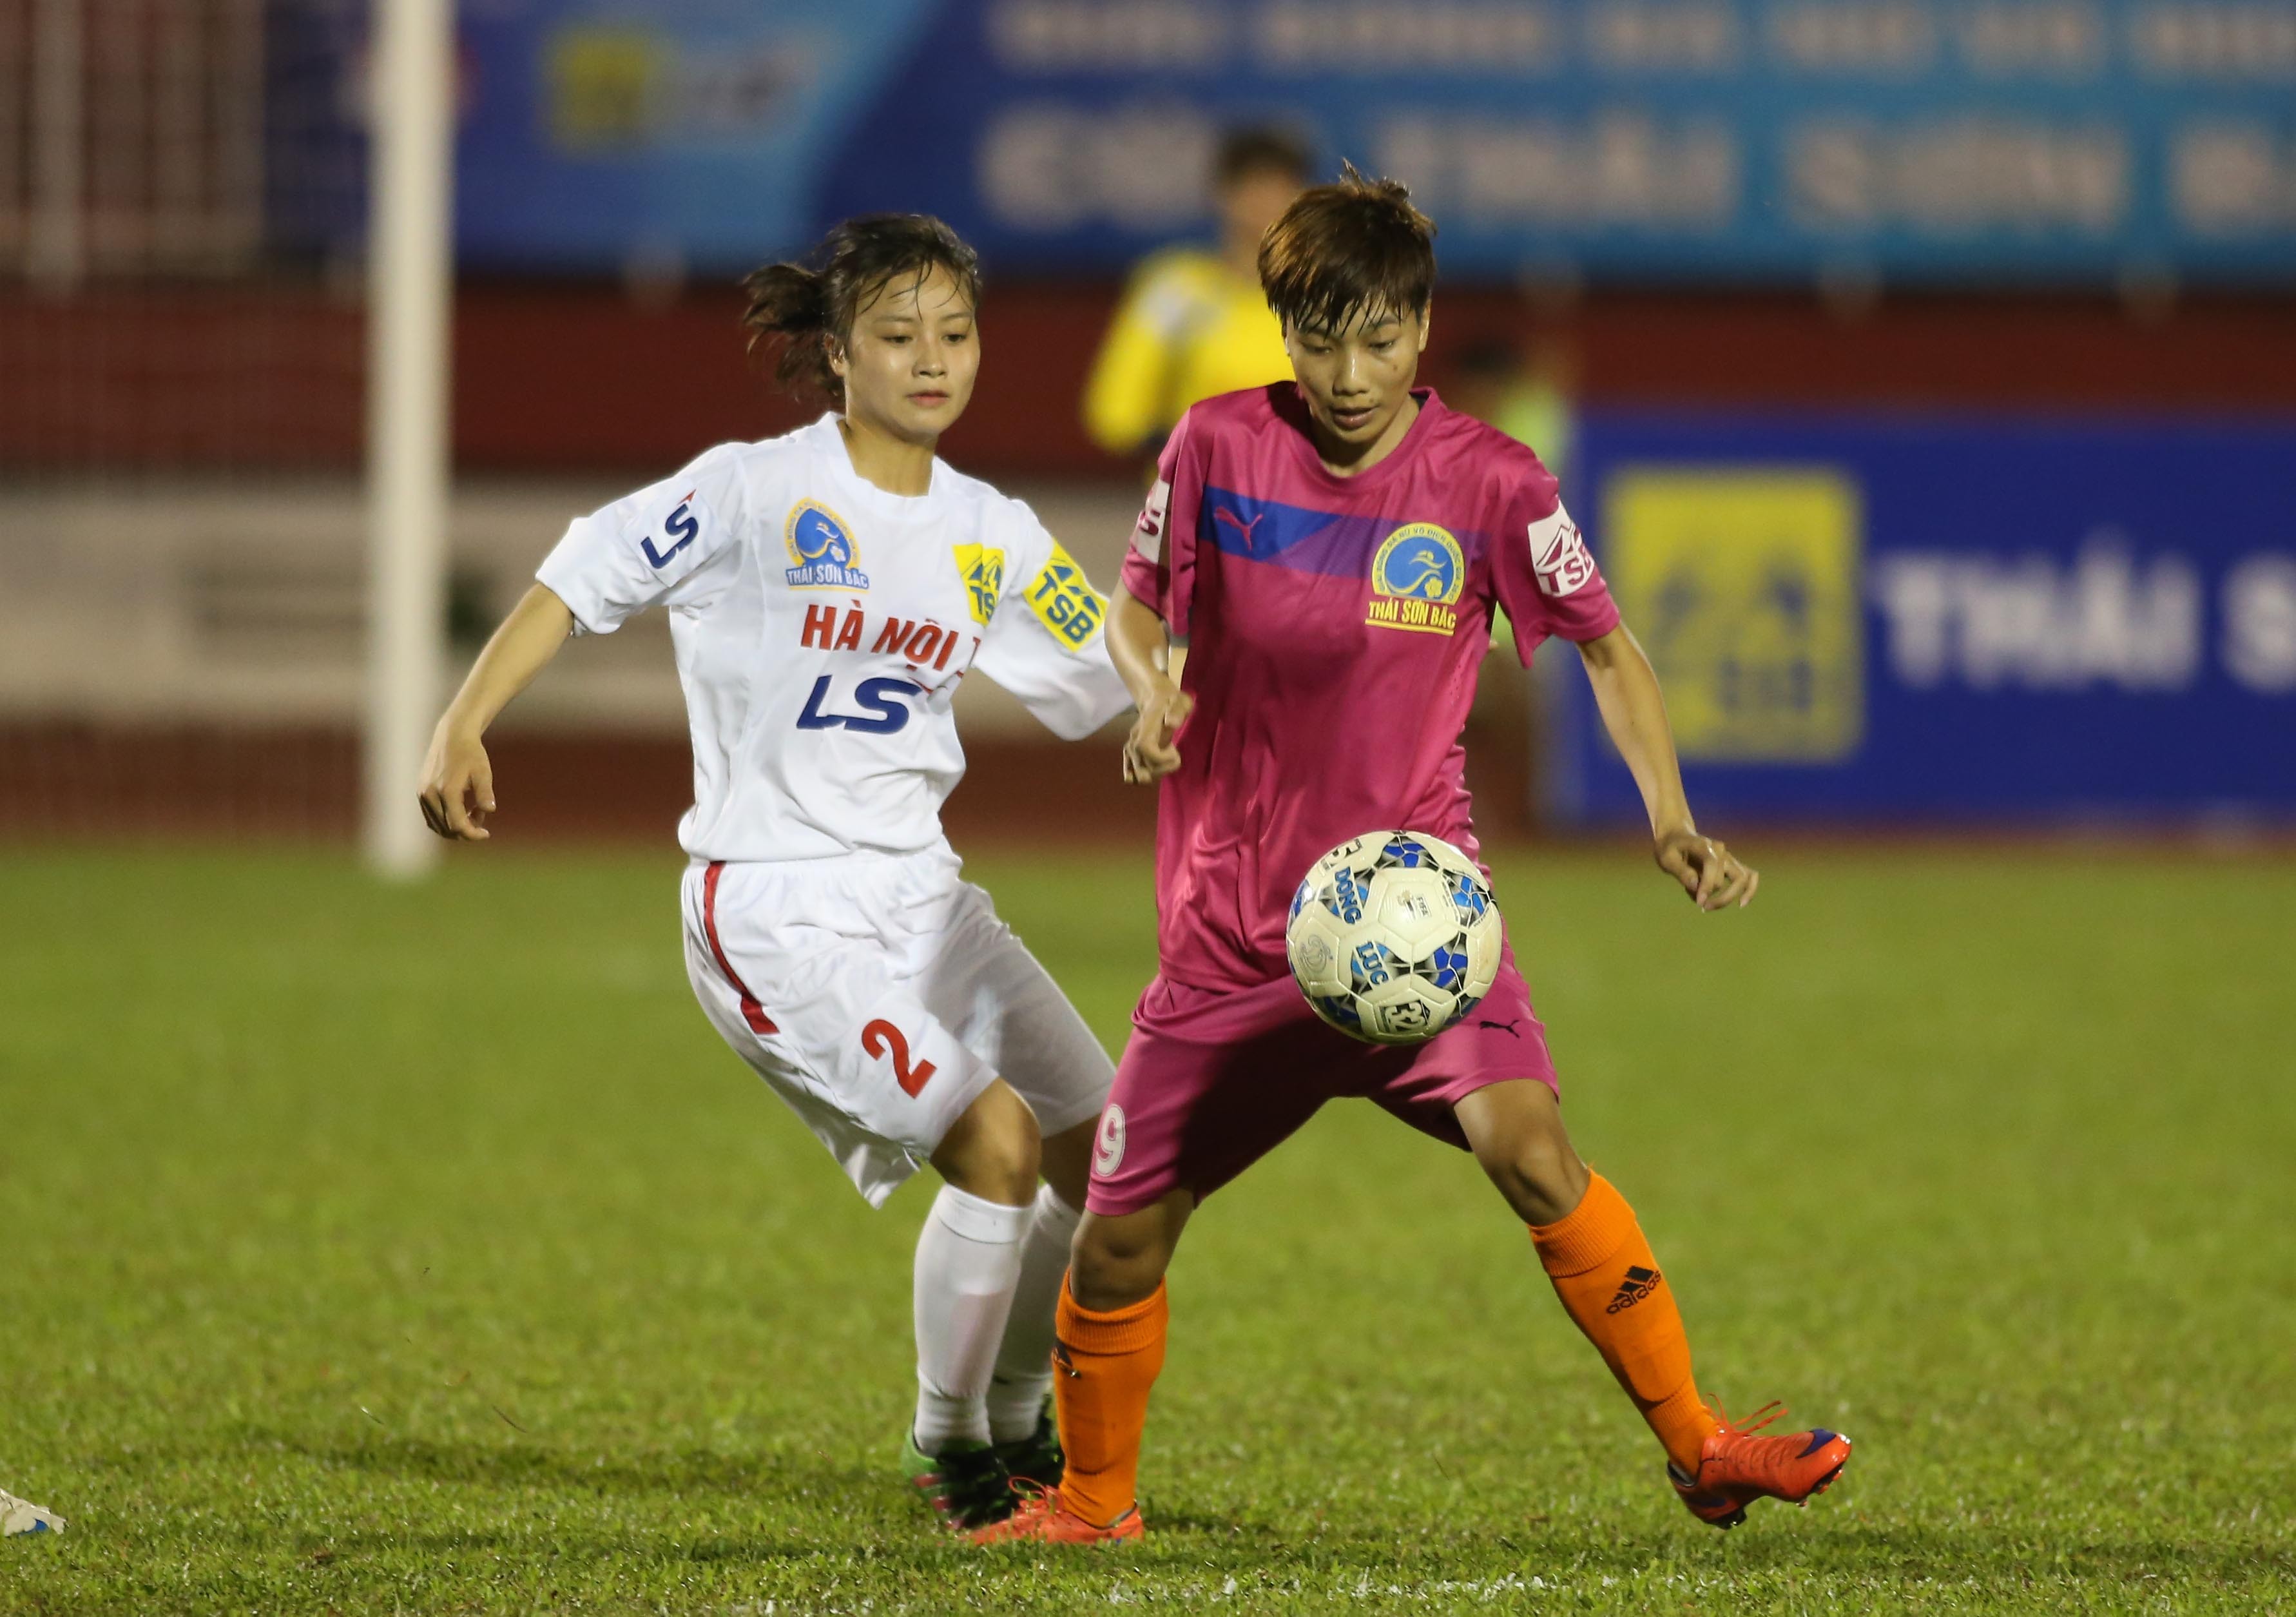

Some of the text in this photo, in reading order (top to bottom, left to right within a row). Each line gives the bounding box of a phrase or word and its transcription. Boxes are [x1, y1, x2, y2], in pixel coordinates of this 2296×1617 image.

[641, 502, 699, 569] LS
[787, 565, 813, 585] THÁI
[1034, 570, 1094, 643] TSB
[800, 599, 864, 651] HÀ
[871, 617, 960, 672] NỘI
[1368, 597, 1399, 622] THÁI
[1401, 599, 1429, 625] SƠN
[796, 674, 923, 735] LS
[862, 1018, 938, 1099] 2
[1096, 1104, 1125, 1177] 9
[1606, 1270, 1661, 1315] adidas
